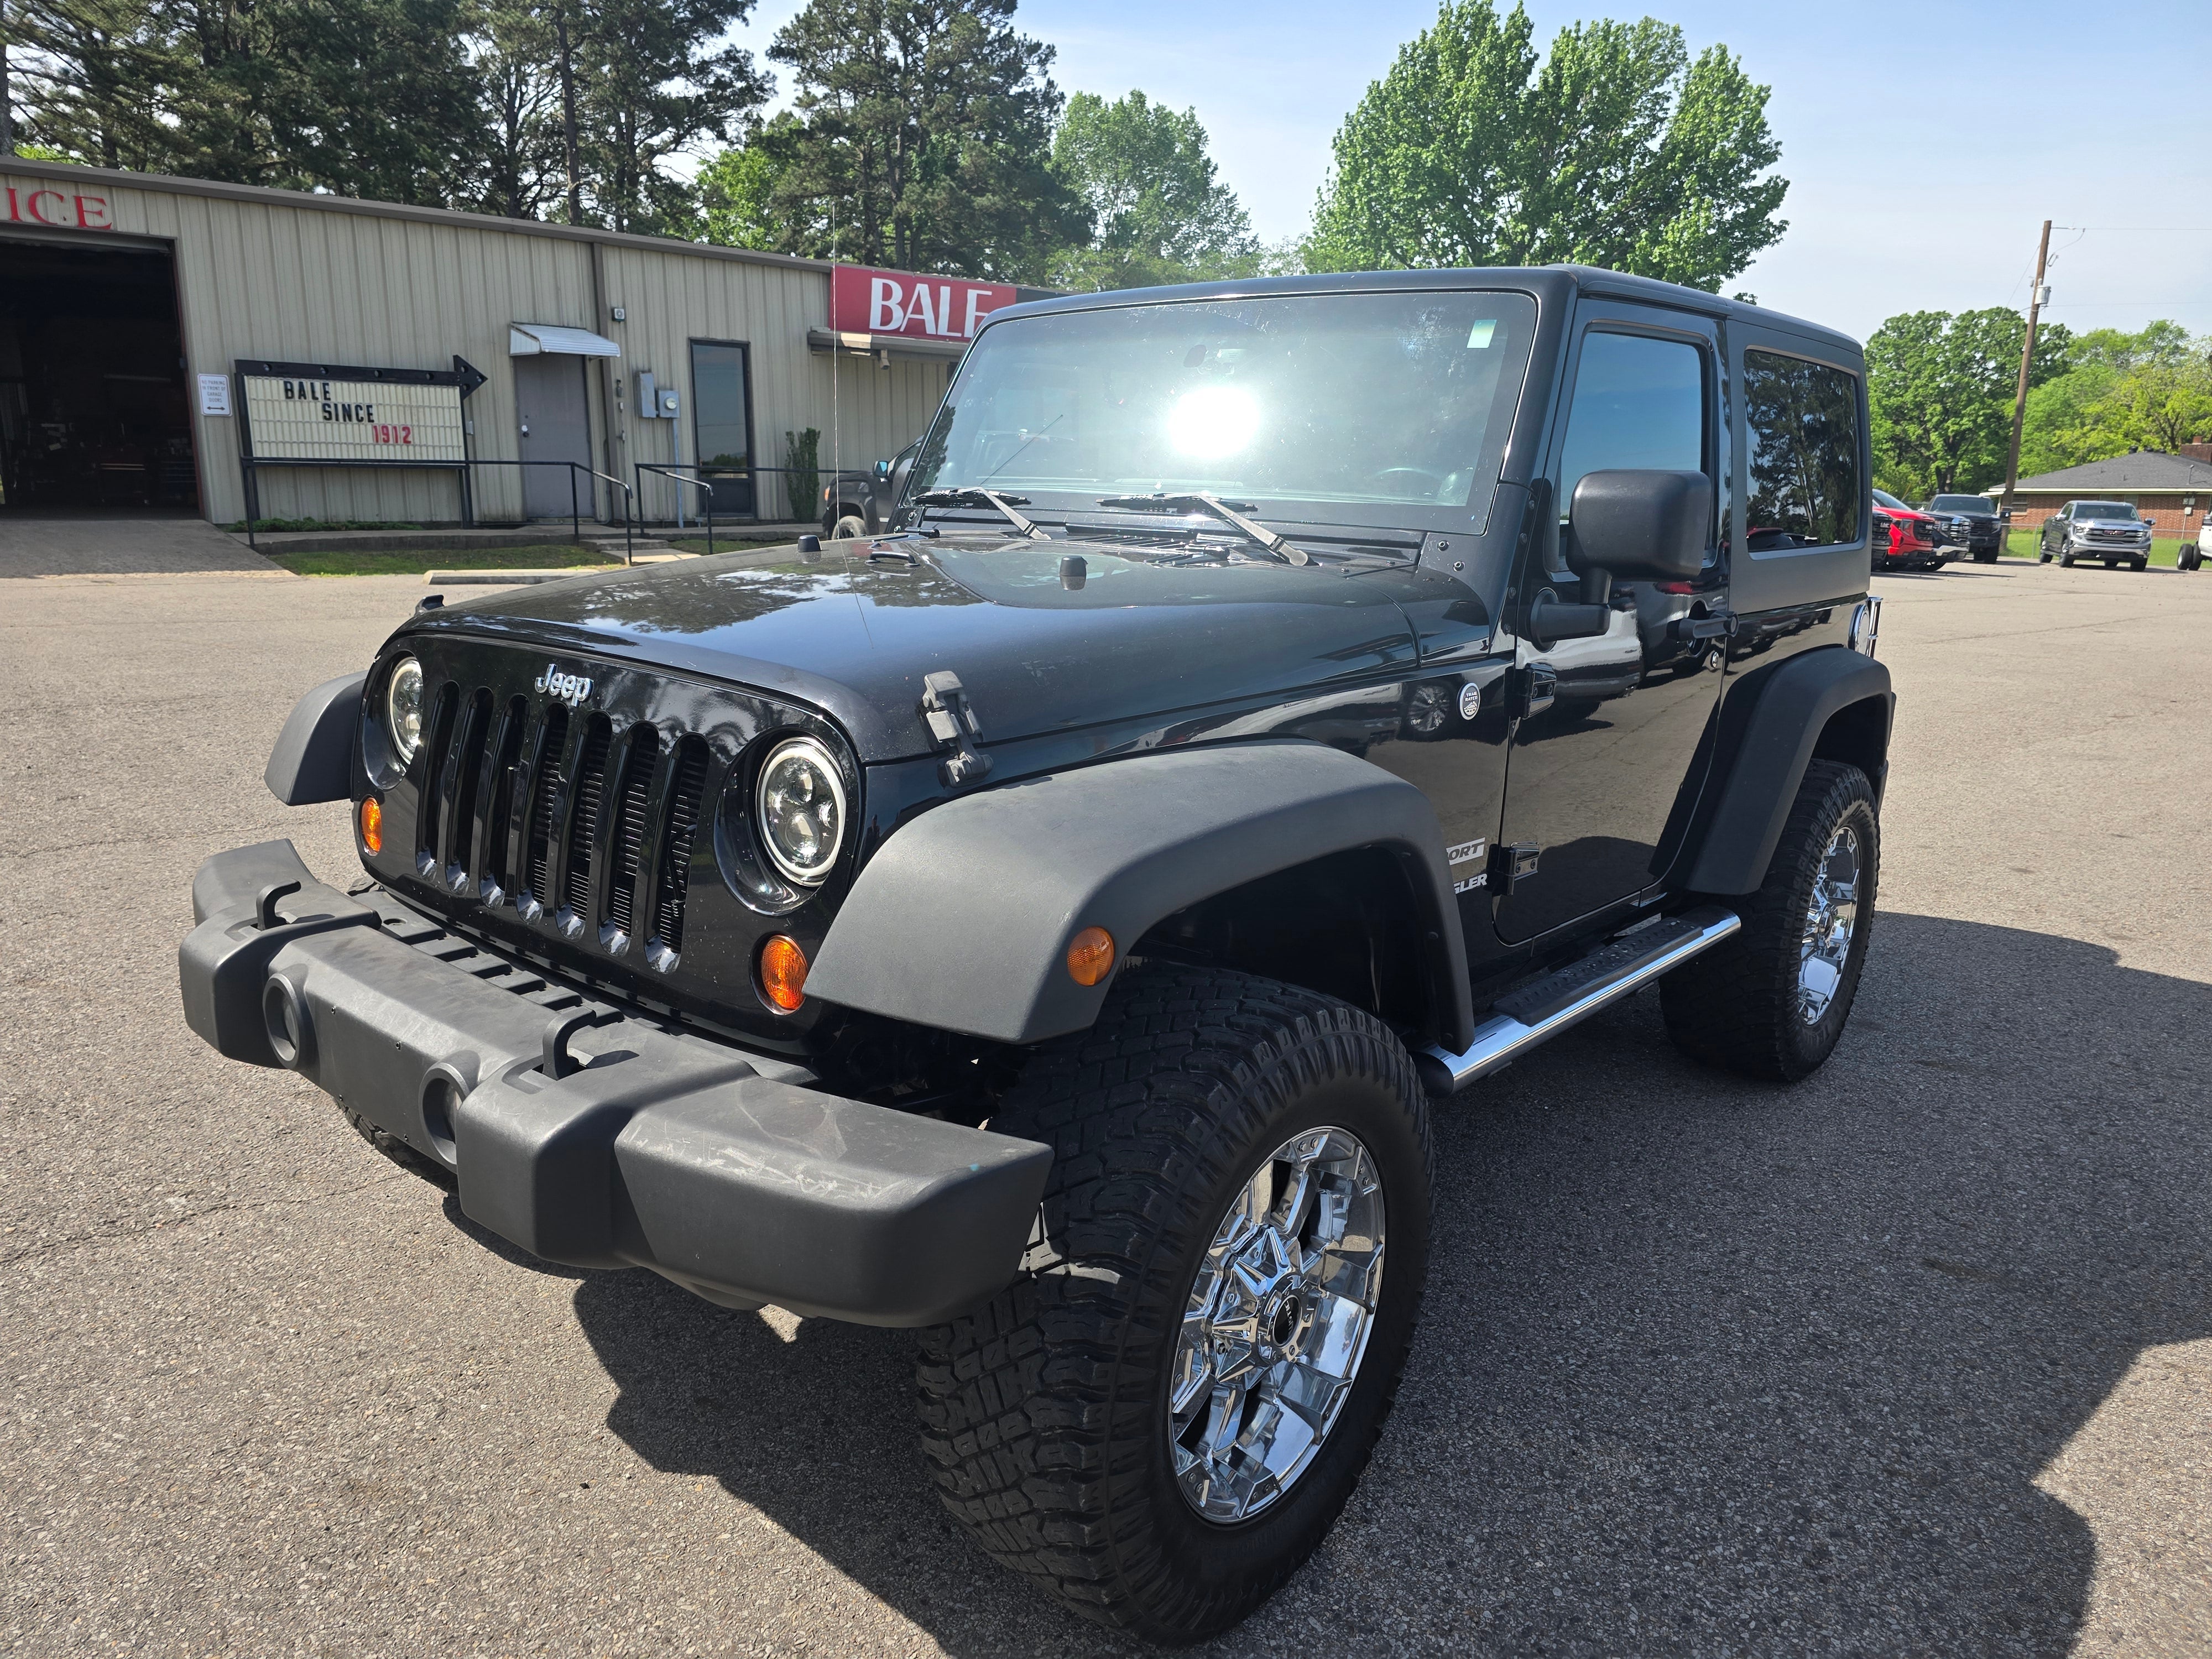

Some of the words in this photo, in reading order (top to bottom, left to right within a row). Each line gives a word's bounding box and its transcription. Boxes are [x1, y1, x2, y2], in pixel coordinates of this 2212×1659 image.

[284, 380, 331, 401] BALE
[322, 403, 375, 423] SINCE
[373, 425, 411, 444] 1912
[535, 664, 594, 707] Jeep
[1448, 842, 1485, 860] ORT
